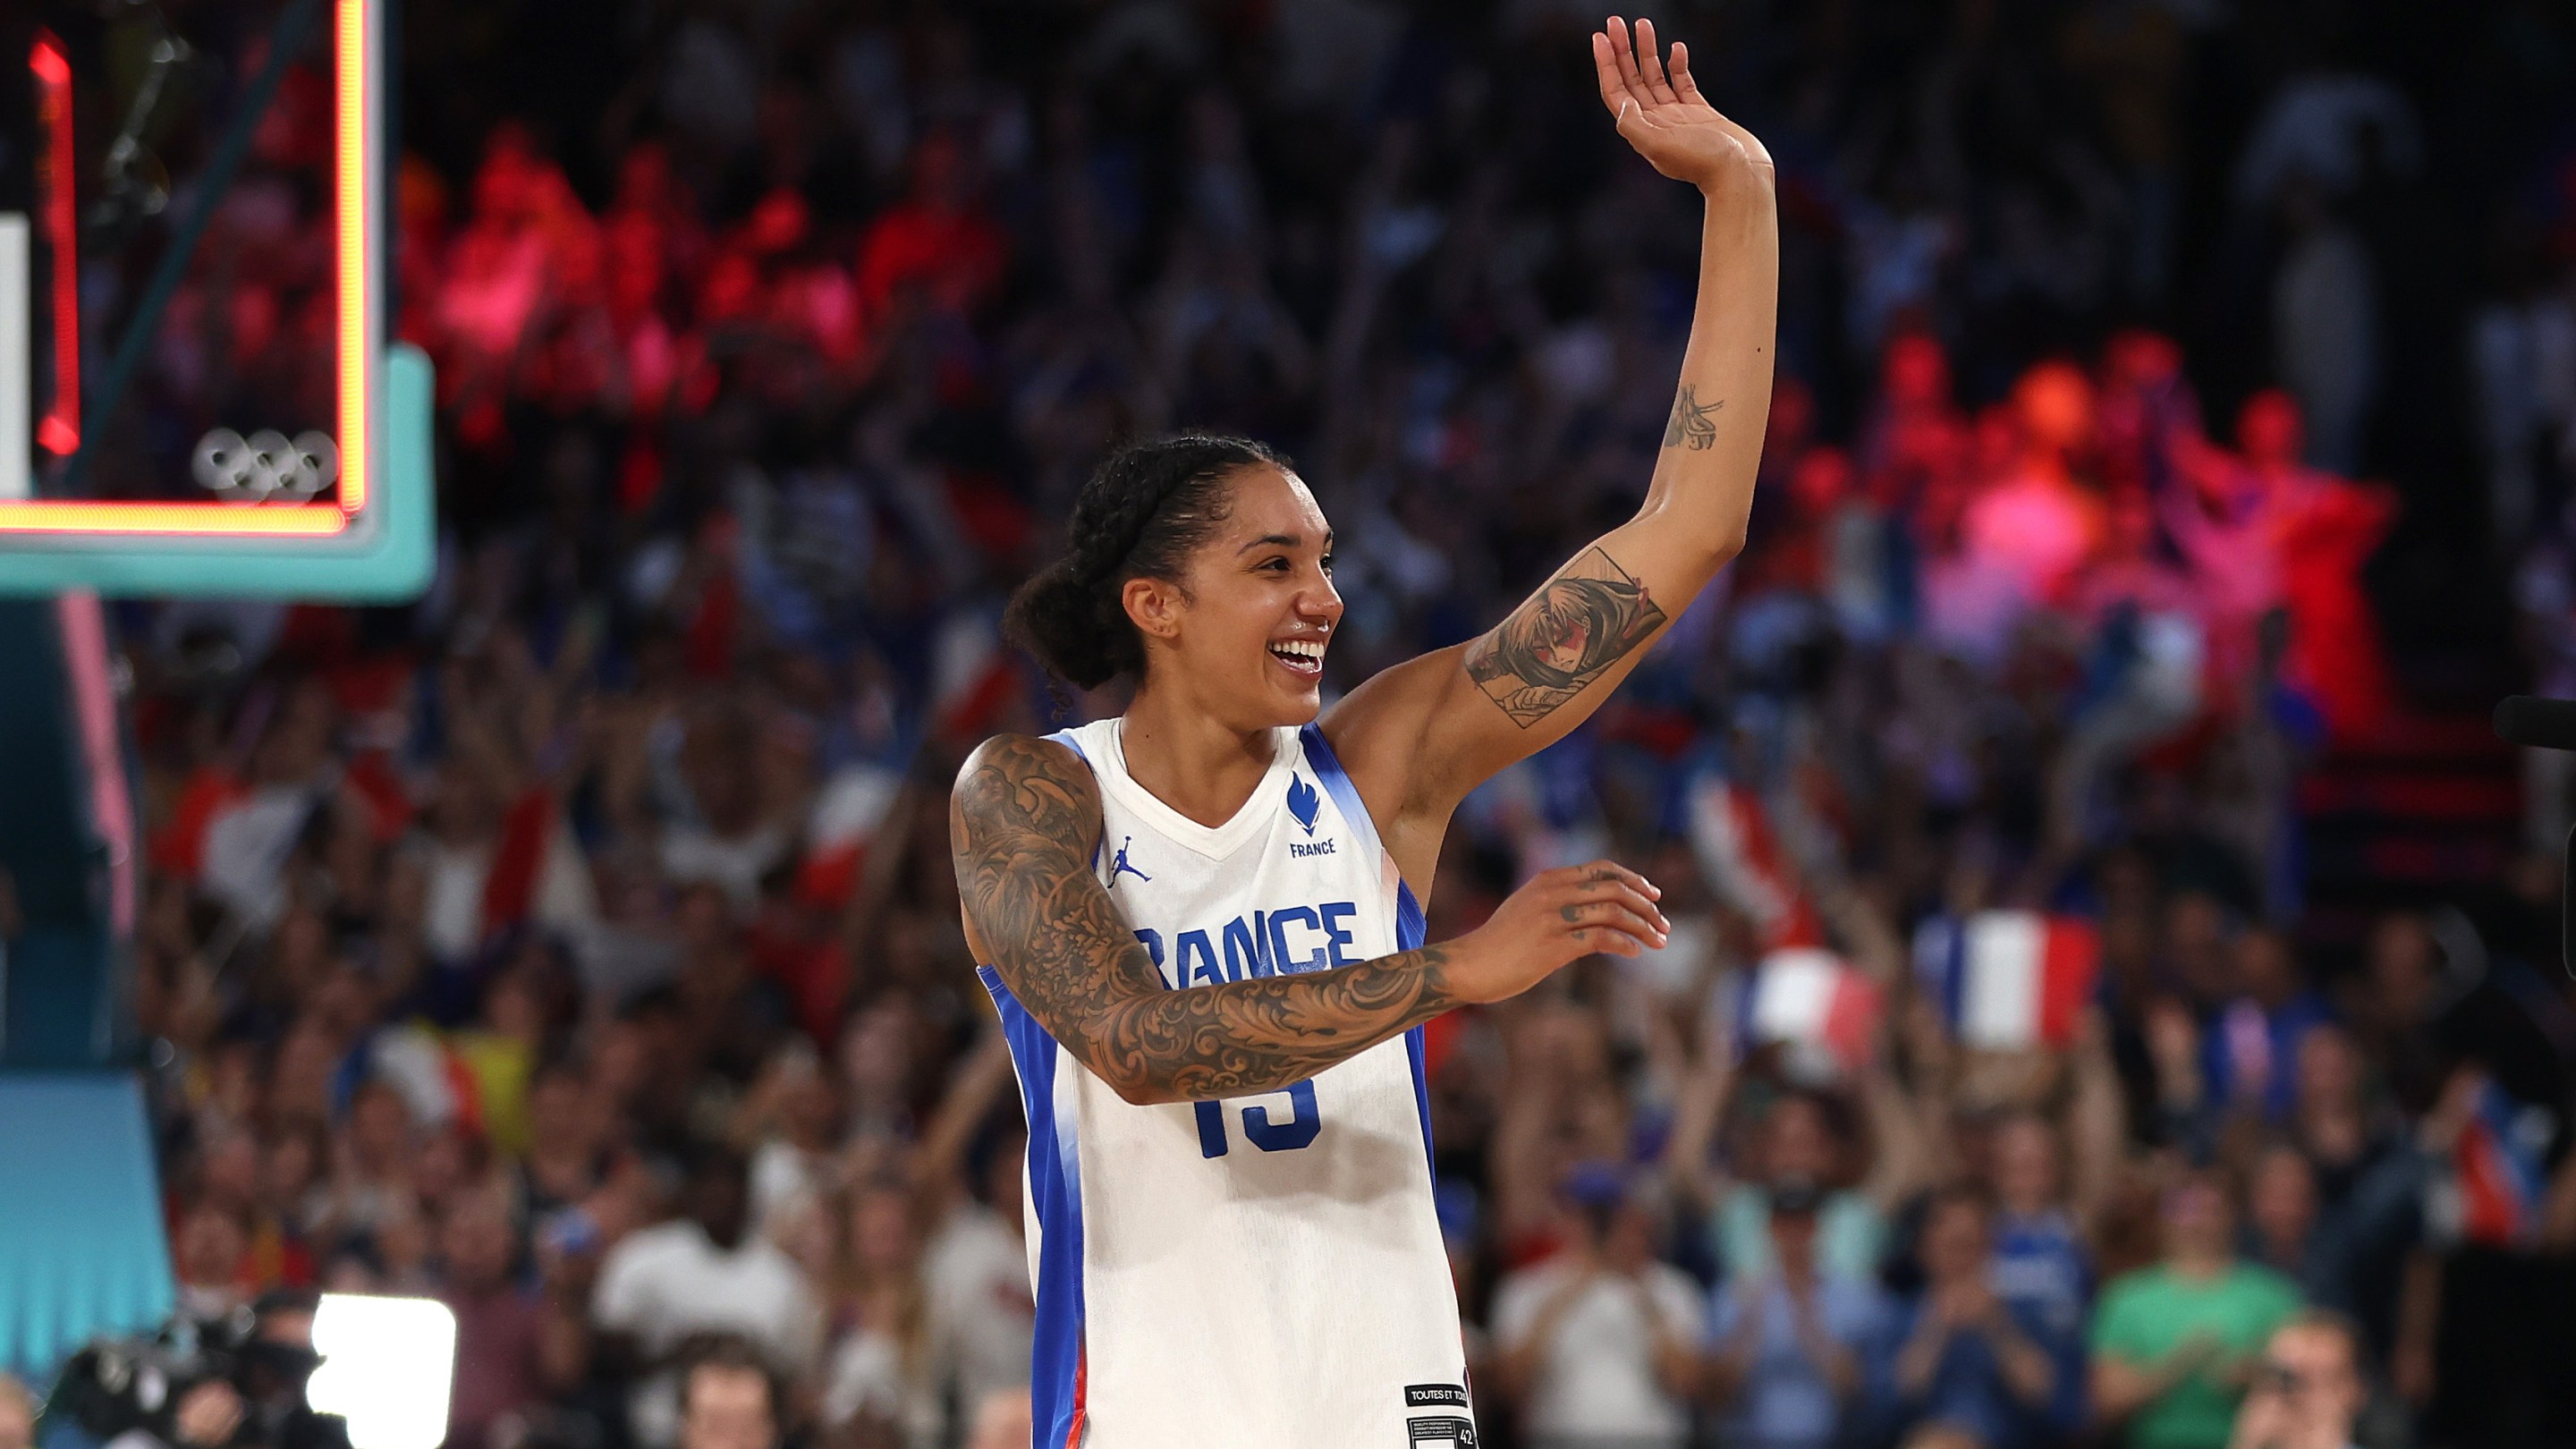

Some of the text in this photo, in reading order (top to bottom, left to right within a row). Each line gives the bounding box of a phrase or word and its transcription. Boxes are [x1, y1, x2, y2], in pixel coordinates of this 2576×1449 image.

[1290, 837, 1336, 859] FRANCE
[1133, 902, 1365, 991] RANCE
[1411, 1389, 1445, 1401] TOUTES
[1445, 1390, 1453, 1400] ET
[1460, 1428, 1474, 1445] 42
